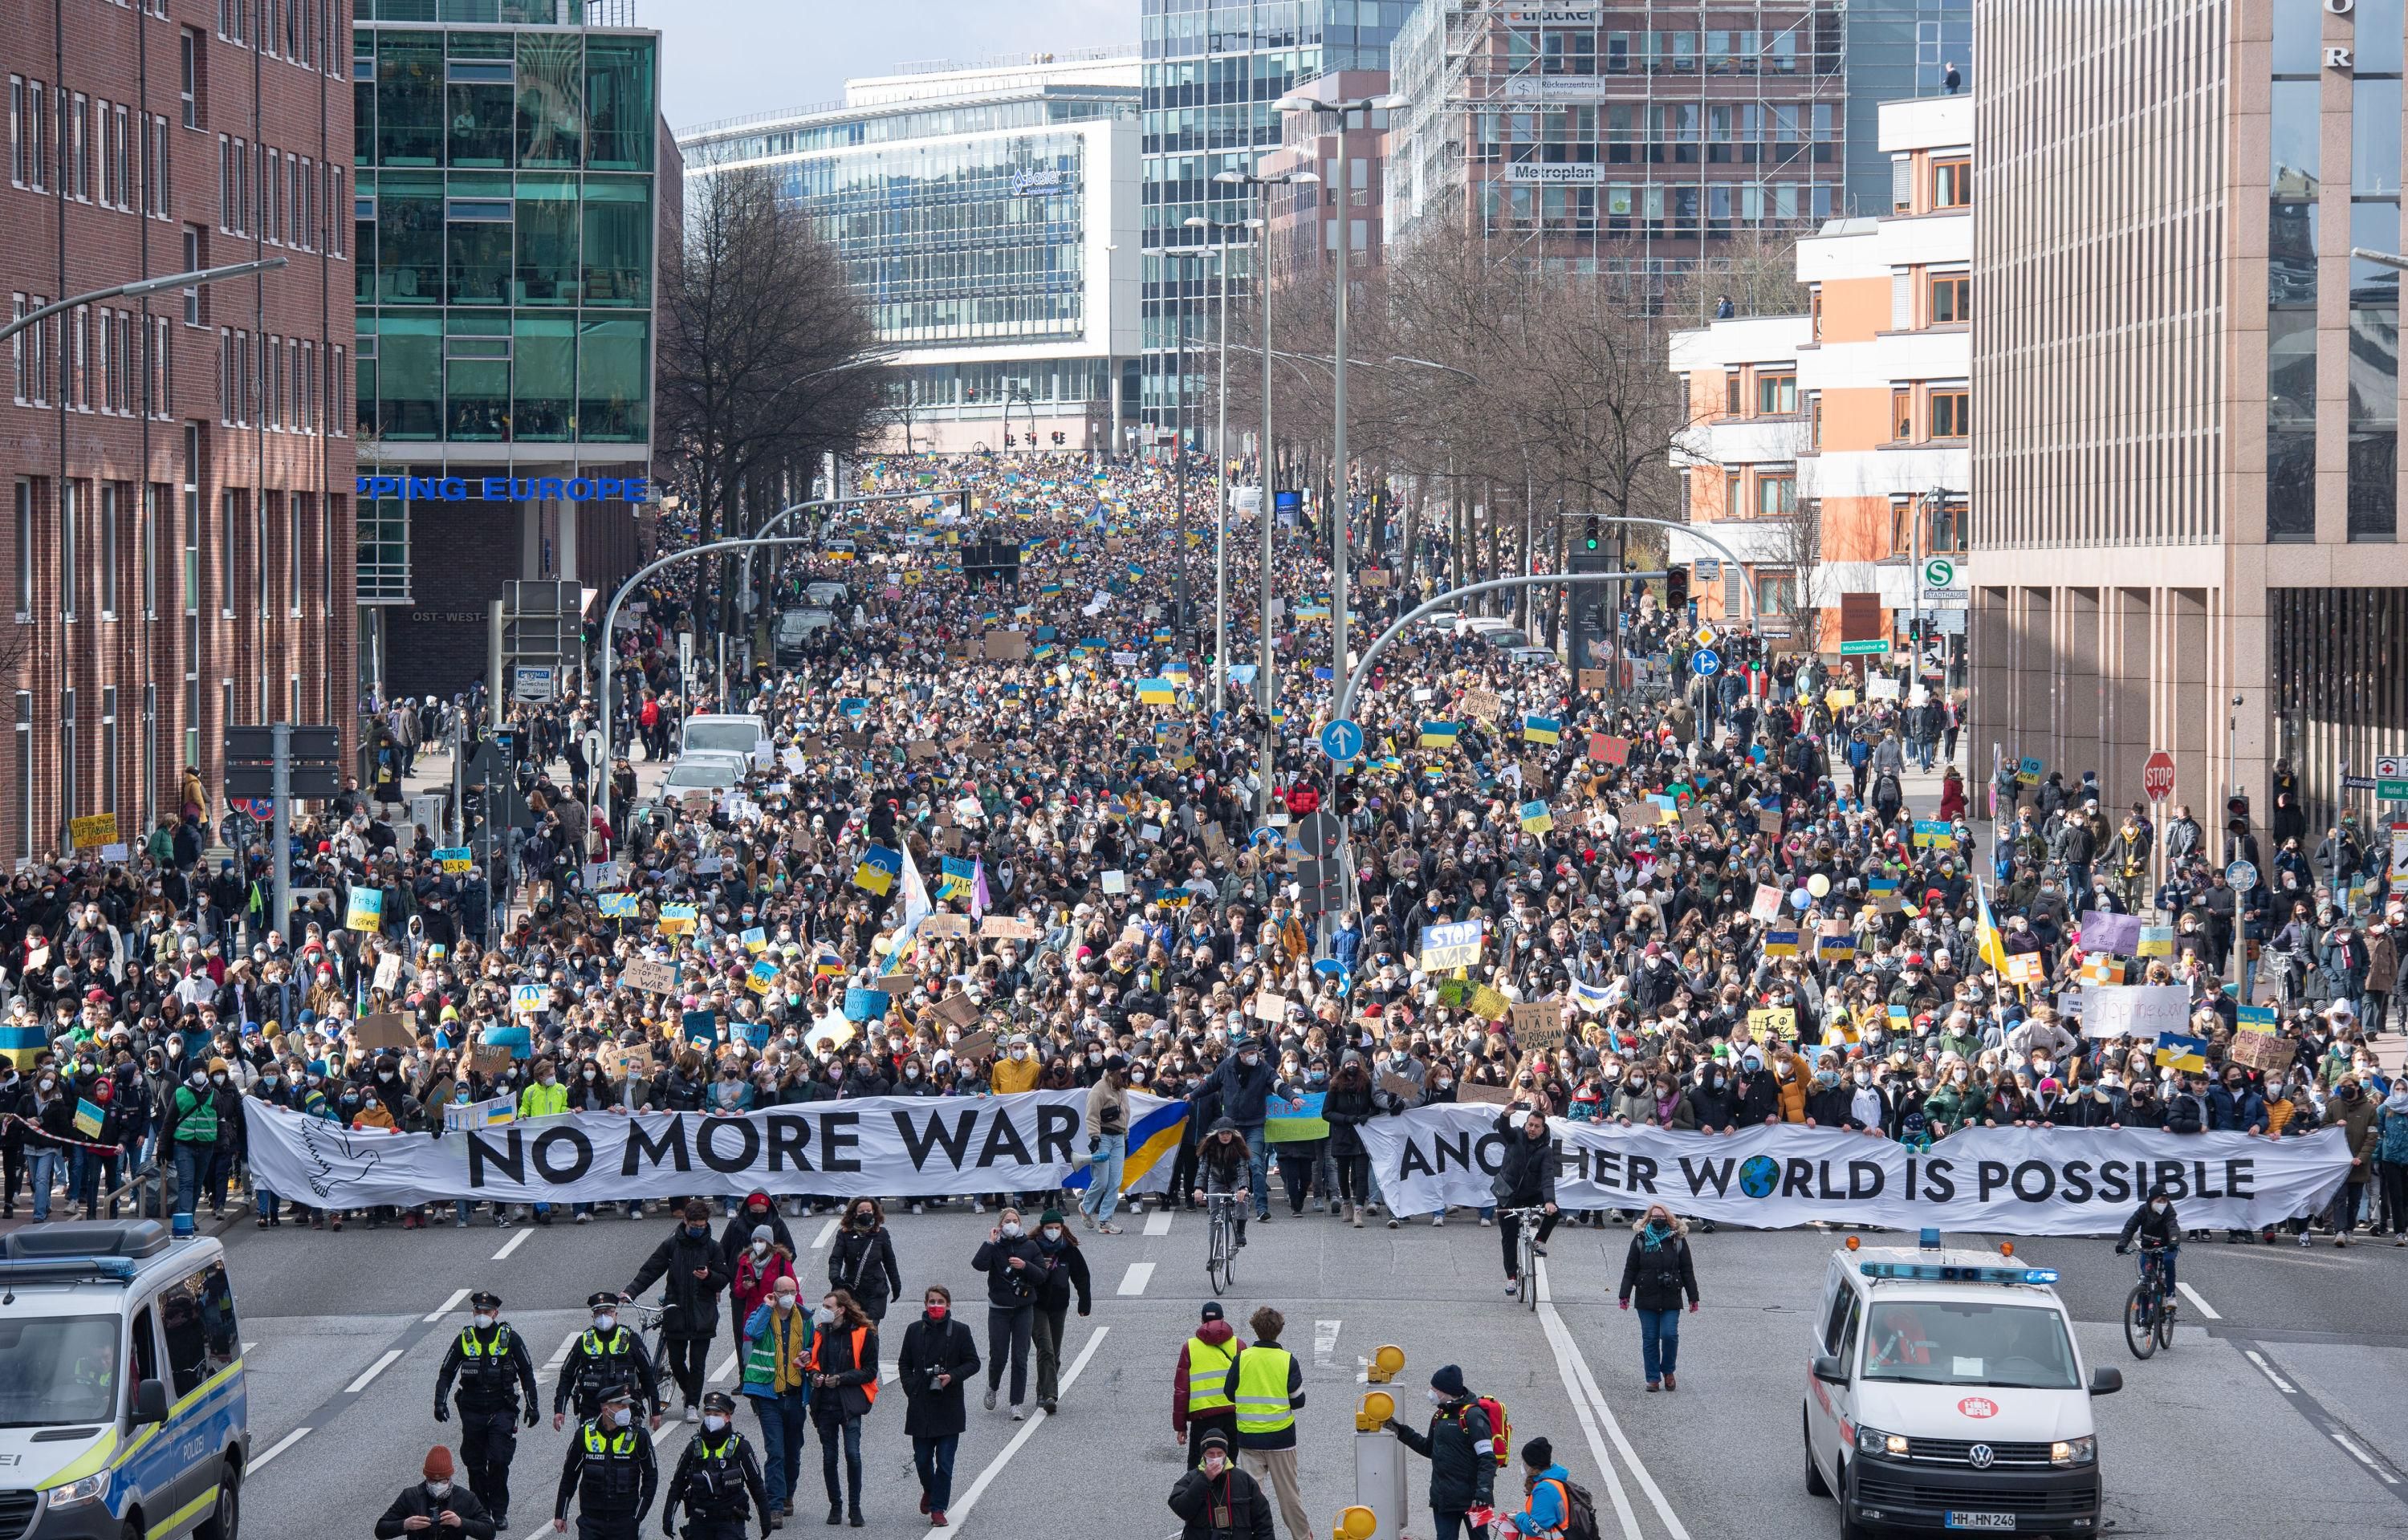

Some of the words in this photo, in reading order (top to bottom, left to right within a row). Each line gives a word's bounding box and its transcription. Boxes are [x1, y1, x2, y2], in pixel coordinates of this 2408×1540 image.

[1027, 165, 1061, 185] Basler
[1515, 165, 1595, 180] Metroplan
[482, 477, 648, 503] EUROPE
[1842, 643, 1878, 652] Michaelishof
[2146, 766, 2174, 787] STOP
[2384, 785, 2403, 794] Hotel
[81, 834, 114, 845] SOFORT
[437, 848, 464, 859] STOP
[948, 858, 976, 875] STOP
[353, 892, 378, 907] Pray
[982, 918, 1003, 934] Stop
[1430, 923, 1477, 948] STOP
[881, 952, 897, 973] PEACE
[1429, 945, 1474, 969] WAR
[632, 967, 653, 977] STOP
[653, 971, 670, 983] THE
[641, 962, 663, 973] PUTIN
[640, 977, 664, 991] WAR
[848, 989, 868, 1000] LOVE
[848, 1001, 865, 1009] NOT
[868, 1001, 885, 1010] WAR
[2089, 990, 2132, 1025] Stop
[2133, 993, 2154, 1016] the
[2157, 999, 2191, 1016] war
[1516, 1034, 1526, 1043] NO
[476, 1044, 504, 1058] STOP
[611, 1050, 628, 1060] WIR
[466, 1126, 594, 1189] NO
[620, 1111, 862, 1176] MORE
[891, 1104, 1080, 1173] WAR
[1400, 1132, 1658, 1194] ANOHER
[1905, 1158, 1956, 1203] IS
[1979, 1158, 2255, 1204] POSSIBLE
[183, 1434, 205, 1464] POLIZEI
[724, 1477, 742, 1486] POLIZEI
[1952, 1512, 1970, 1527] HH
[1975, 1513, 1991, 1528] HN
[1994, 1513, 2014, 1529] 246
